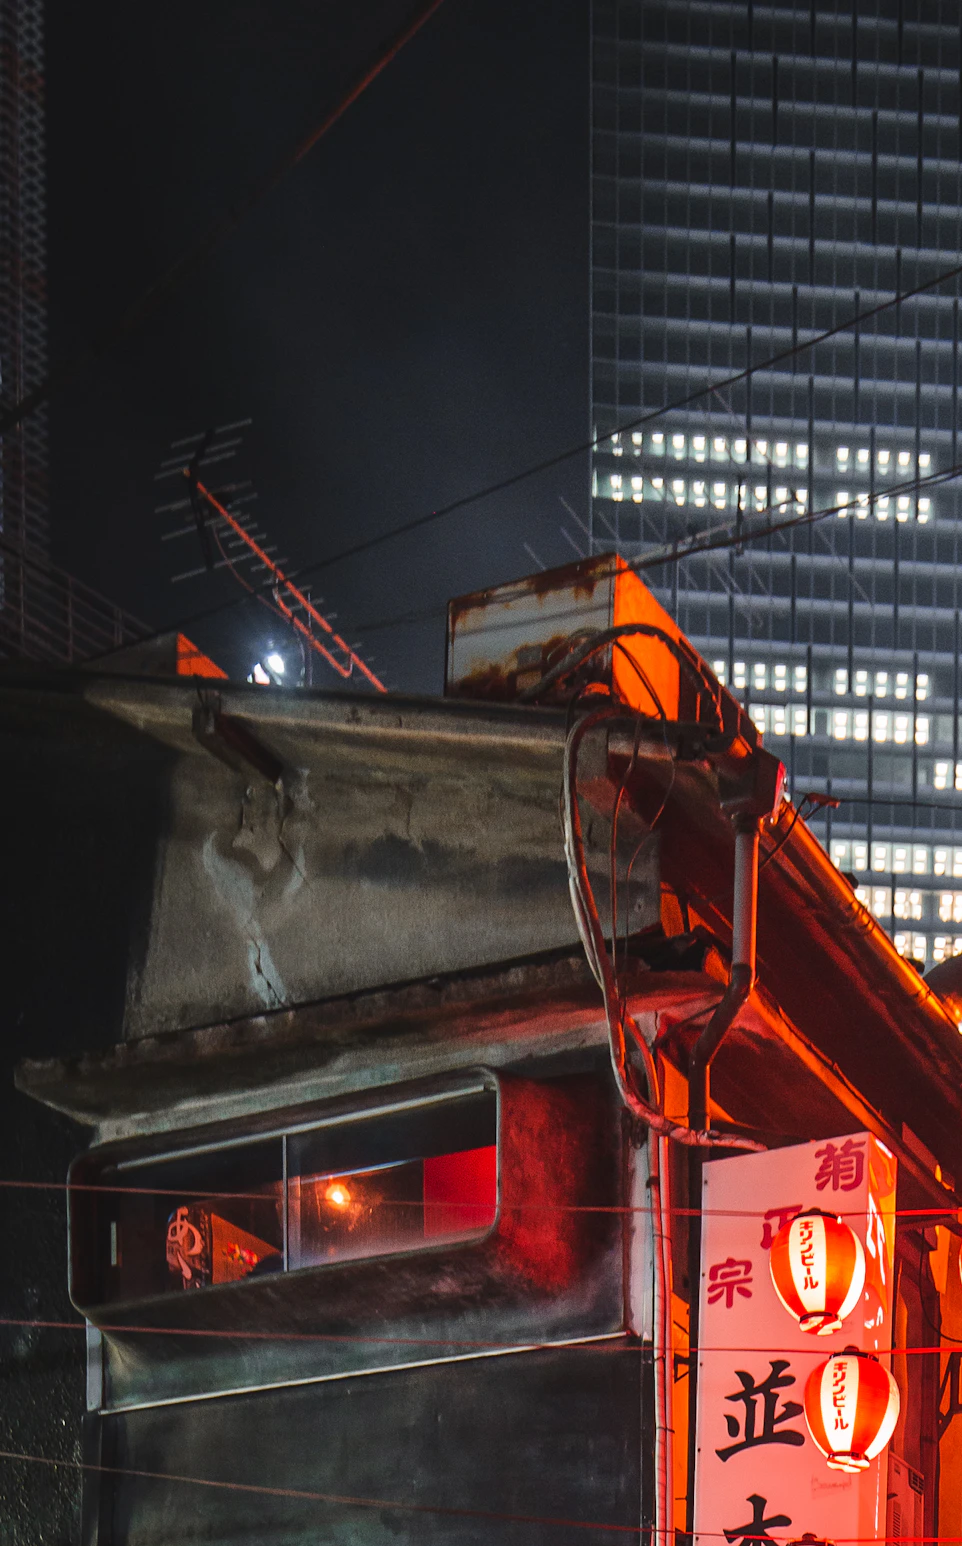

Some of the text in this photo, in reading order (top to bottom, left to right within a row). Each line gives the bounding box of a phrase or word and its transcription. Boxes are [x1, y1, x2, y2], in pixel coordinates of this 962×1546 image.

[798, 1220, 819, 1291] キリンビール
[832, 1361, 849, 1431] キリンビール
